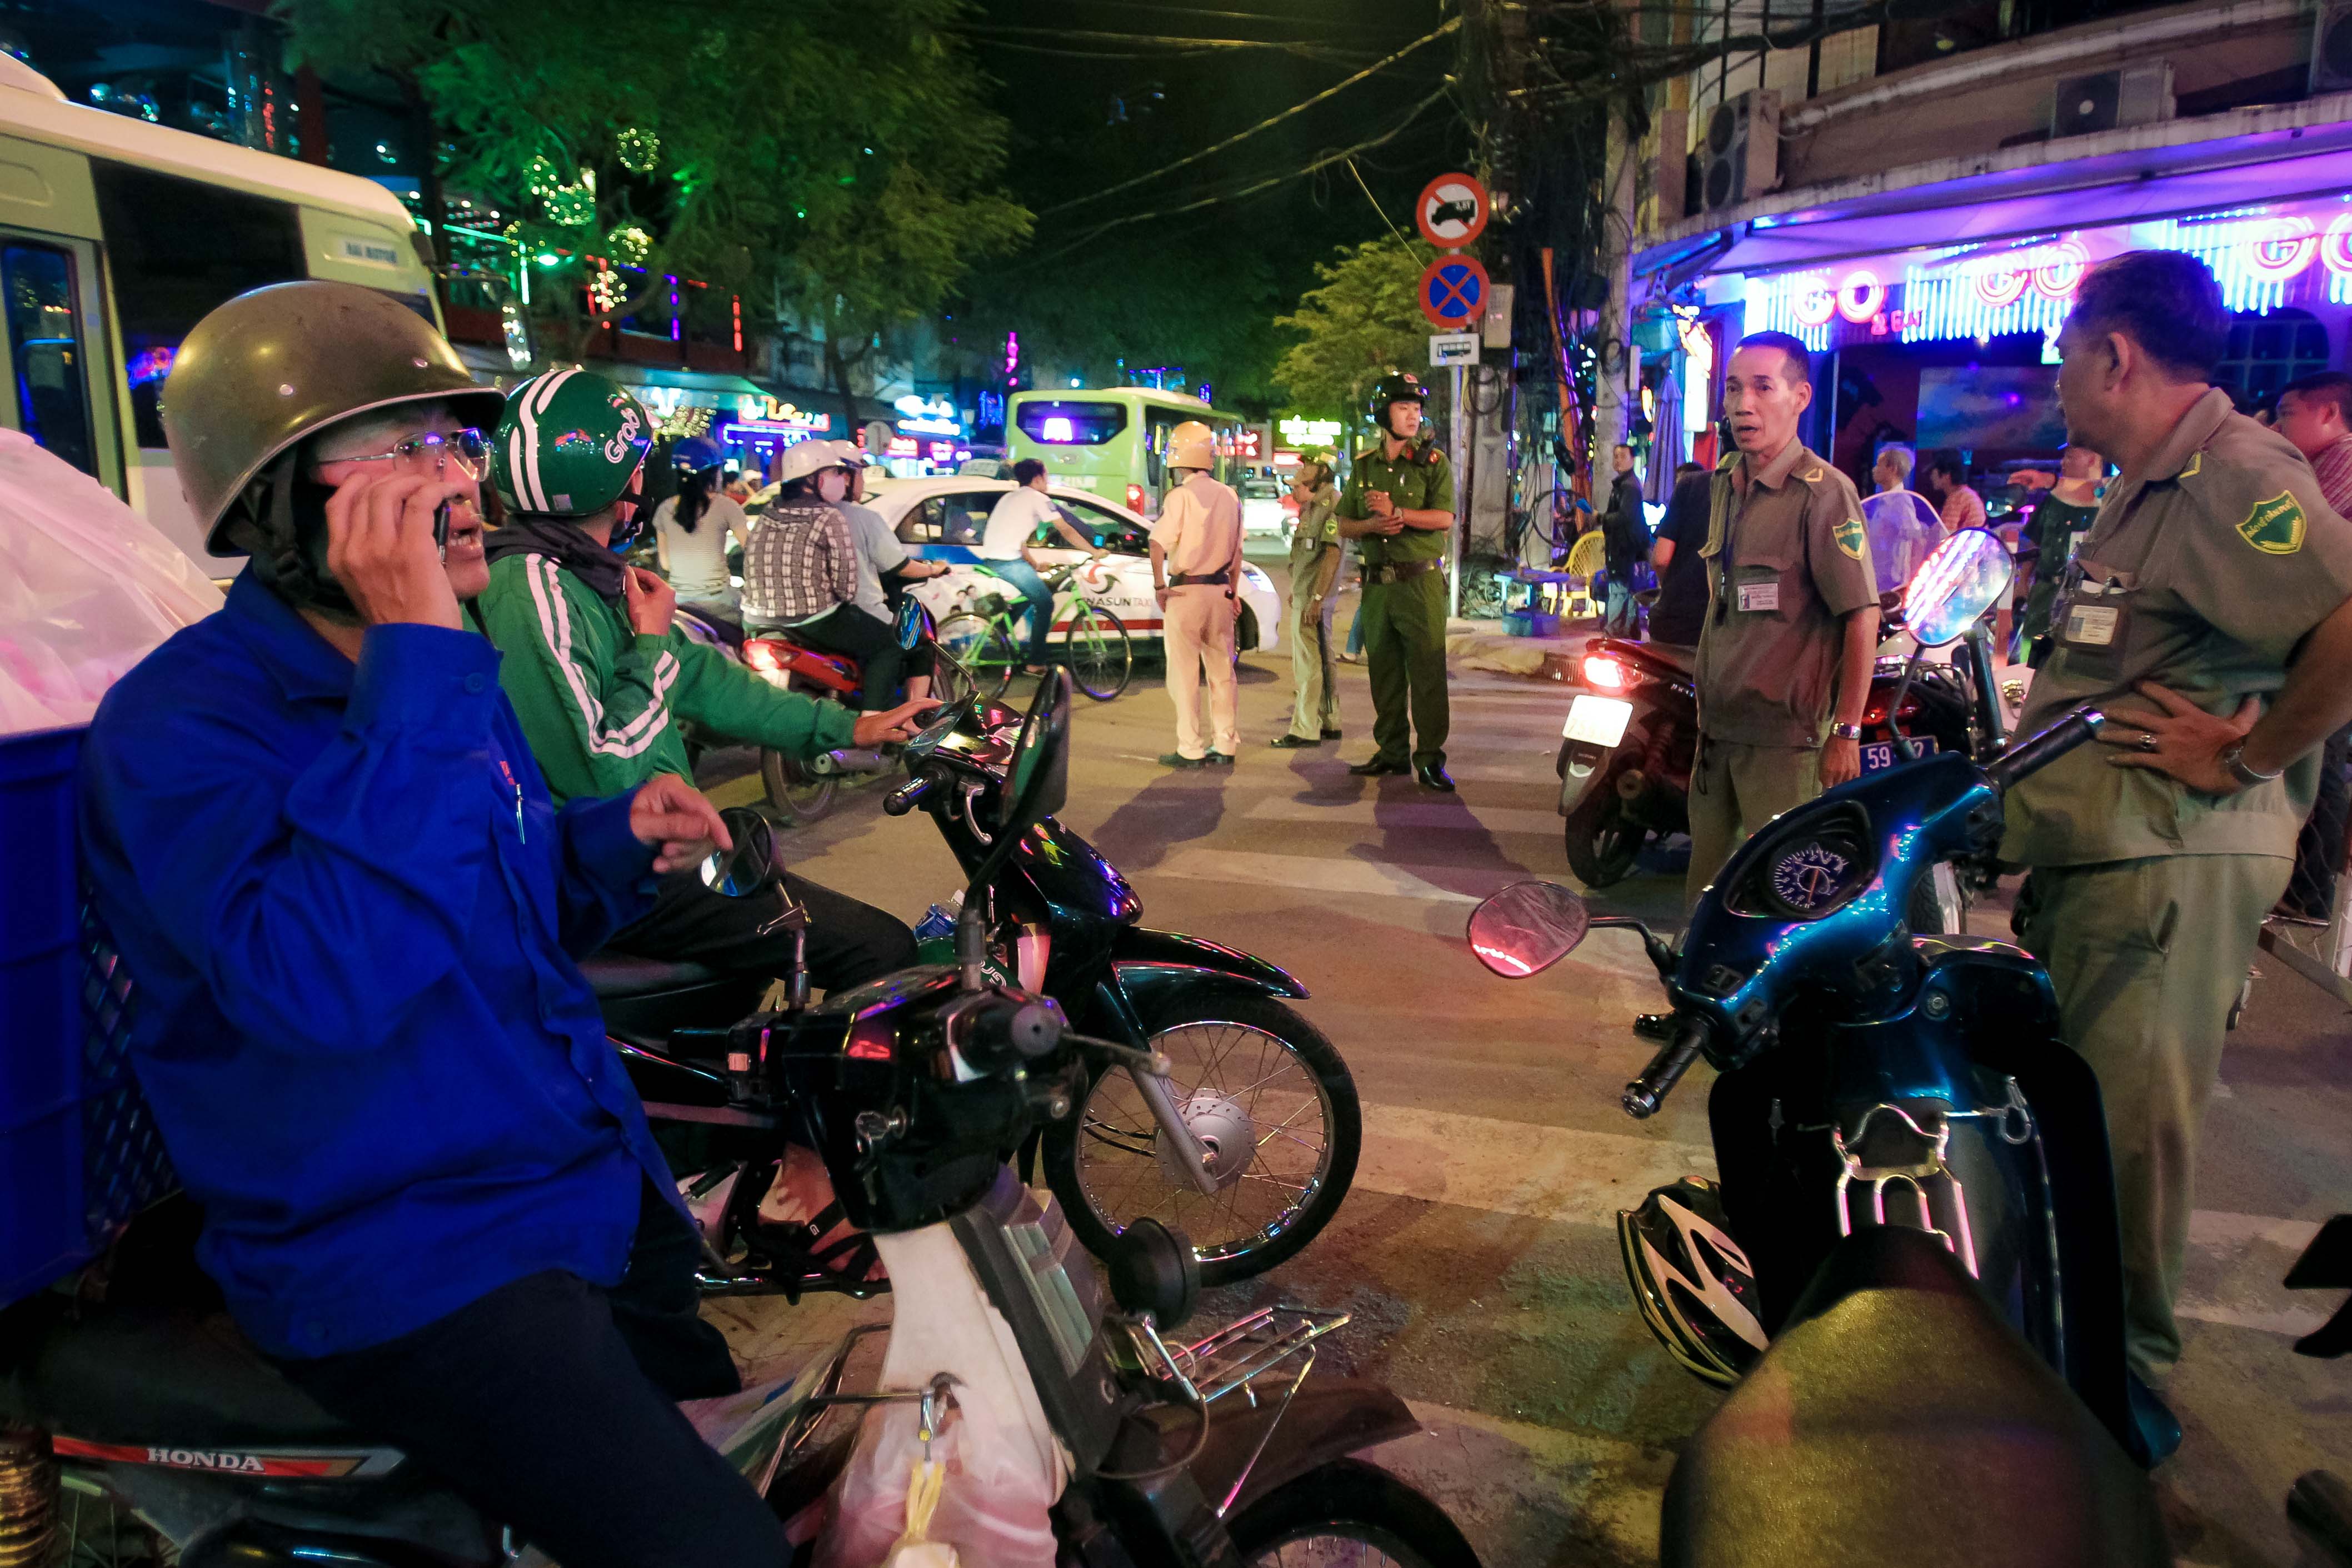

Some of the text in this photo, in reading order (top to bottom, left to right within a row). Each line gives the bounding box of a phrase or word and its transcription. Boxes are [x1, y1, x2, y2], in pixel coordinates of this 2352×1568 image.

[1792, 270, 1887, 327] GO
[604, 407, 641, 463] Grab
[1085, 597, 1131, 607] NASUN
[1867, 746, 1891, 769] 59
[147, 1447, 264, 1471] HONDA
